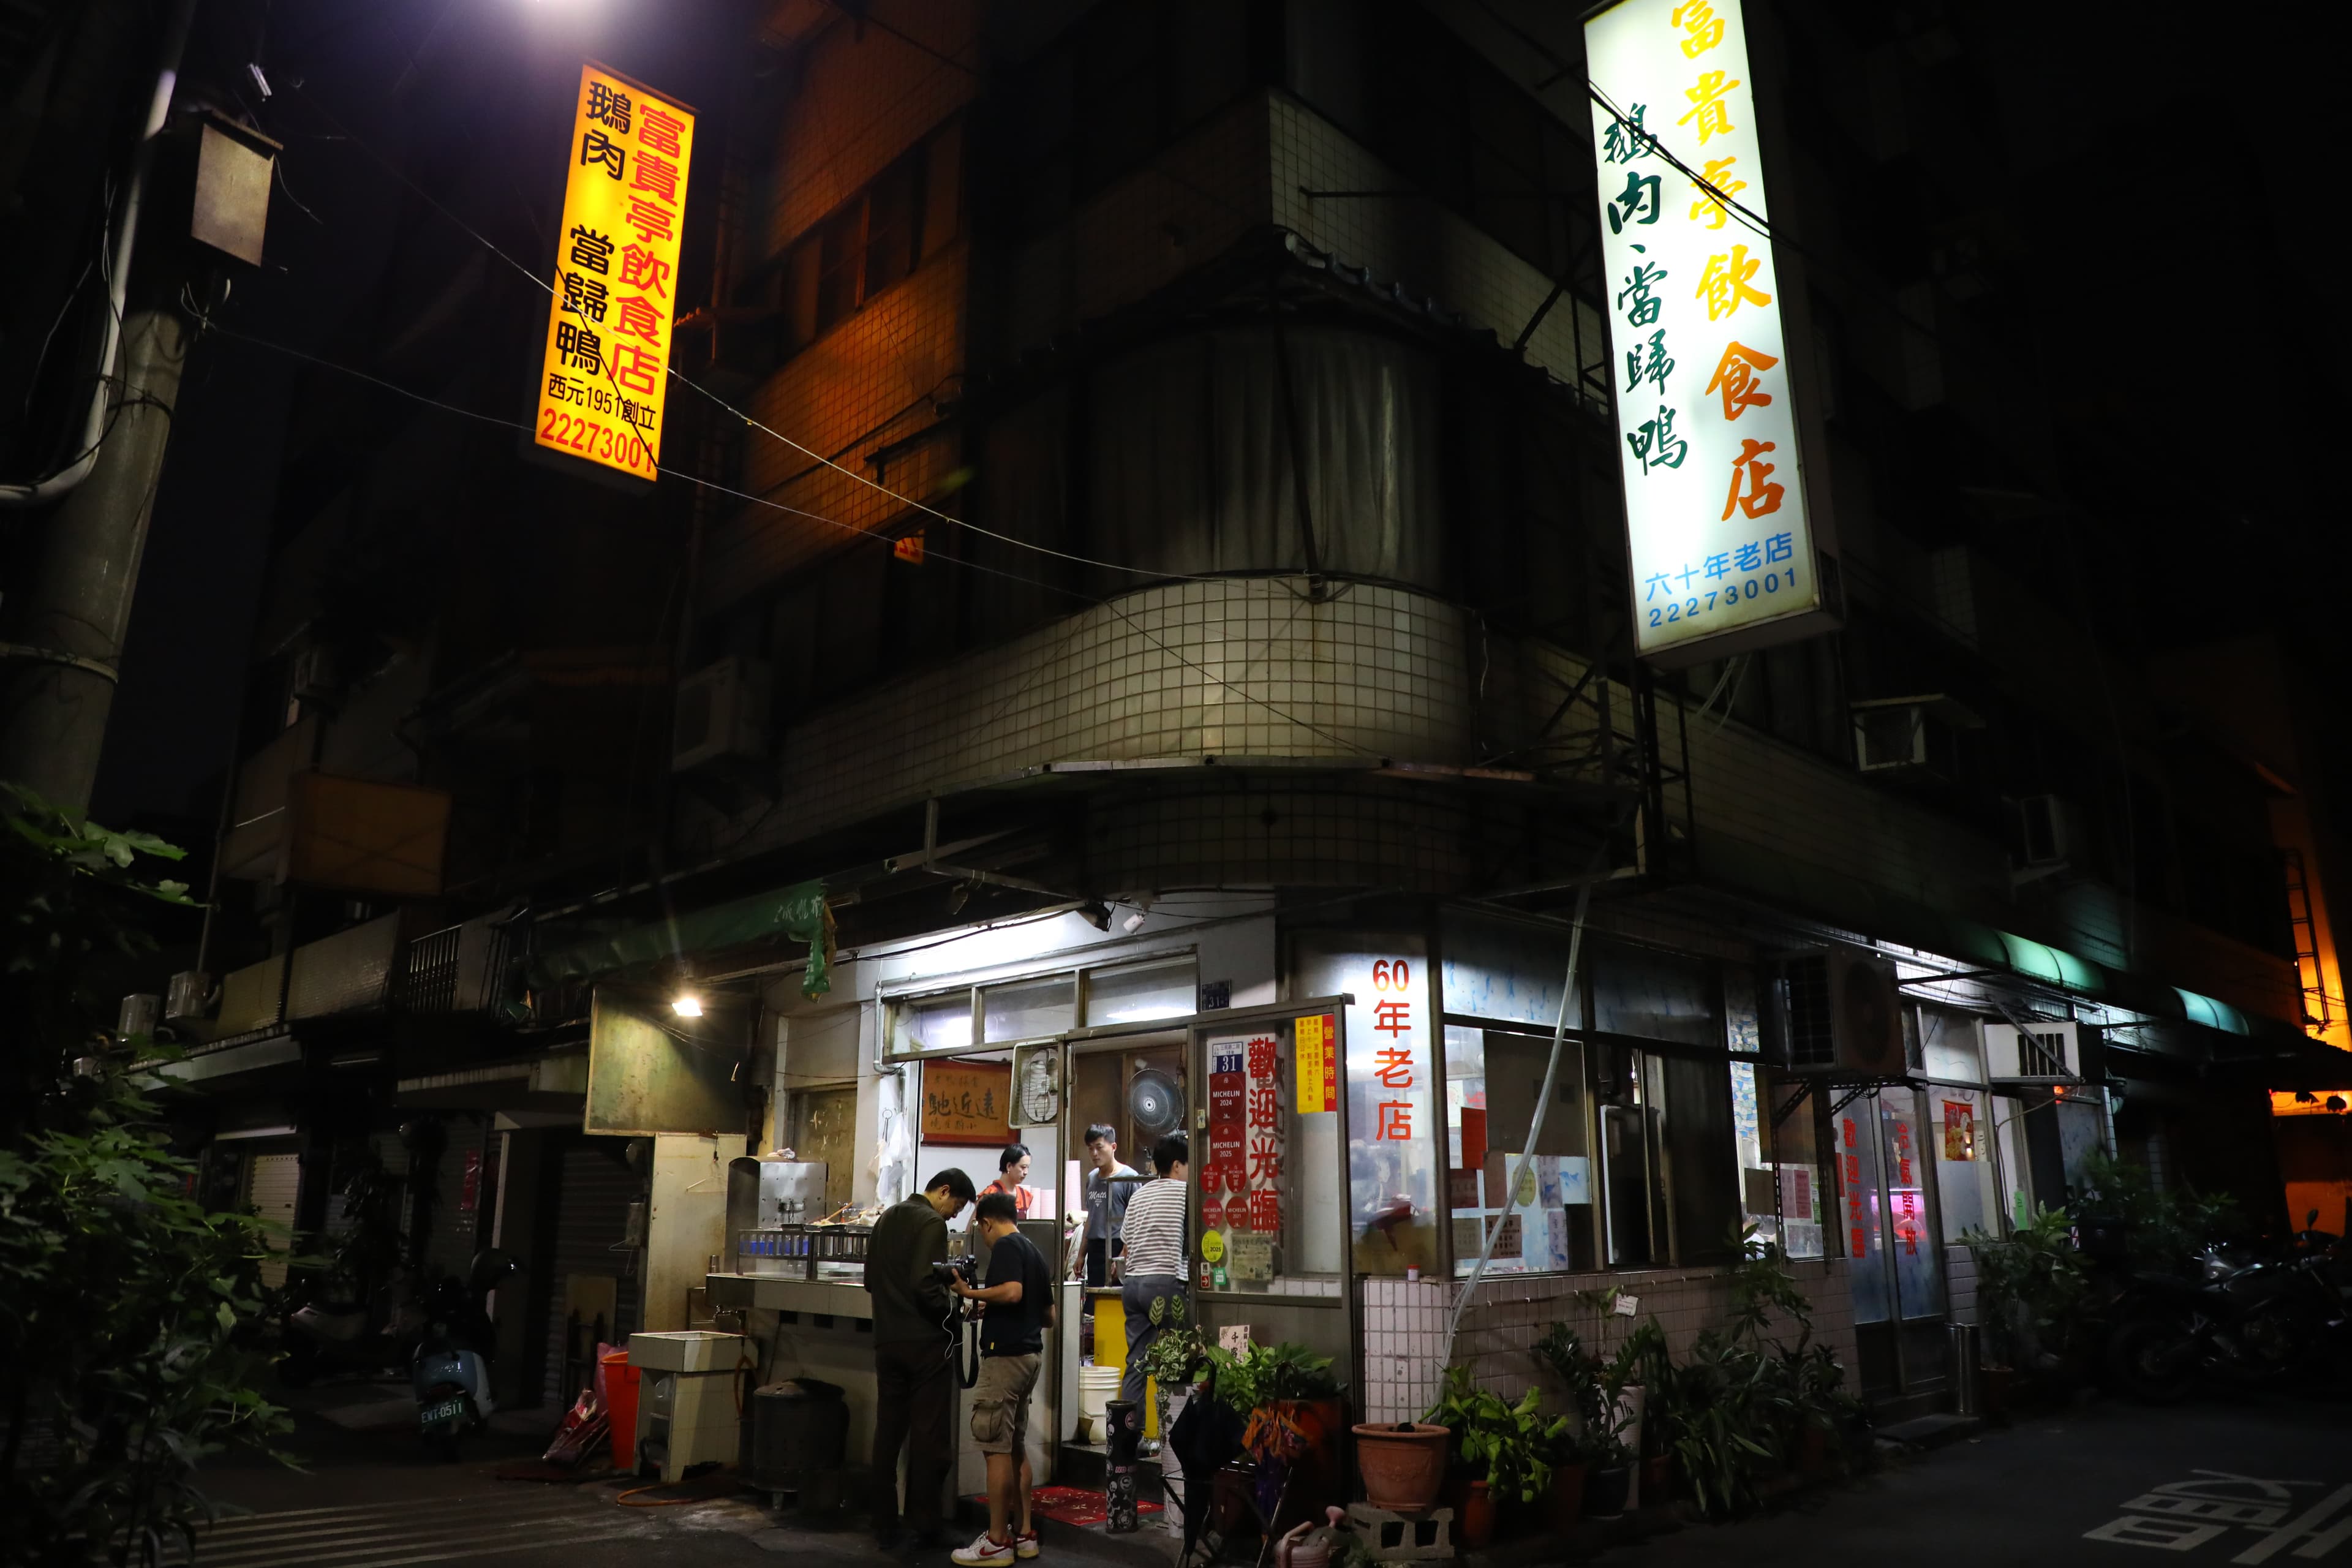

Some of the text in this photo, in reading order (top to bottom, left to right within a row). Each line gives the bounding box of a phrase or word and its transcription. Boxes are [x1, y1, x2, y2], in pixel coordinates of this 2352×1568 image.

[555, 81, 631, 375] 鵝肉 當歸鴨
[606, 103, 685, 395] 富貴亭飲食店
[1672, 0, 1785, 521] 富貴亭飲食店
[548, 373, 657, 431] 西元1951創立
[541, 409, 654, 472] 22273001
[1645, 532, 1792, 601] 六十年老店
[1649, 567, 1795, 627] 22273001
[1222, 1055, 1237, 1072] 31
[1324, 1026, 1335, 1099] 營業時間
[1248, 1036, 1279, 1231] 歡迎光臨
[1896, 1122, 1917, 1255] 冷氣開放
